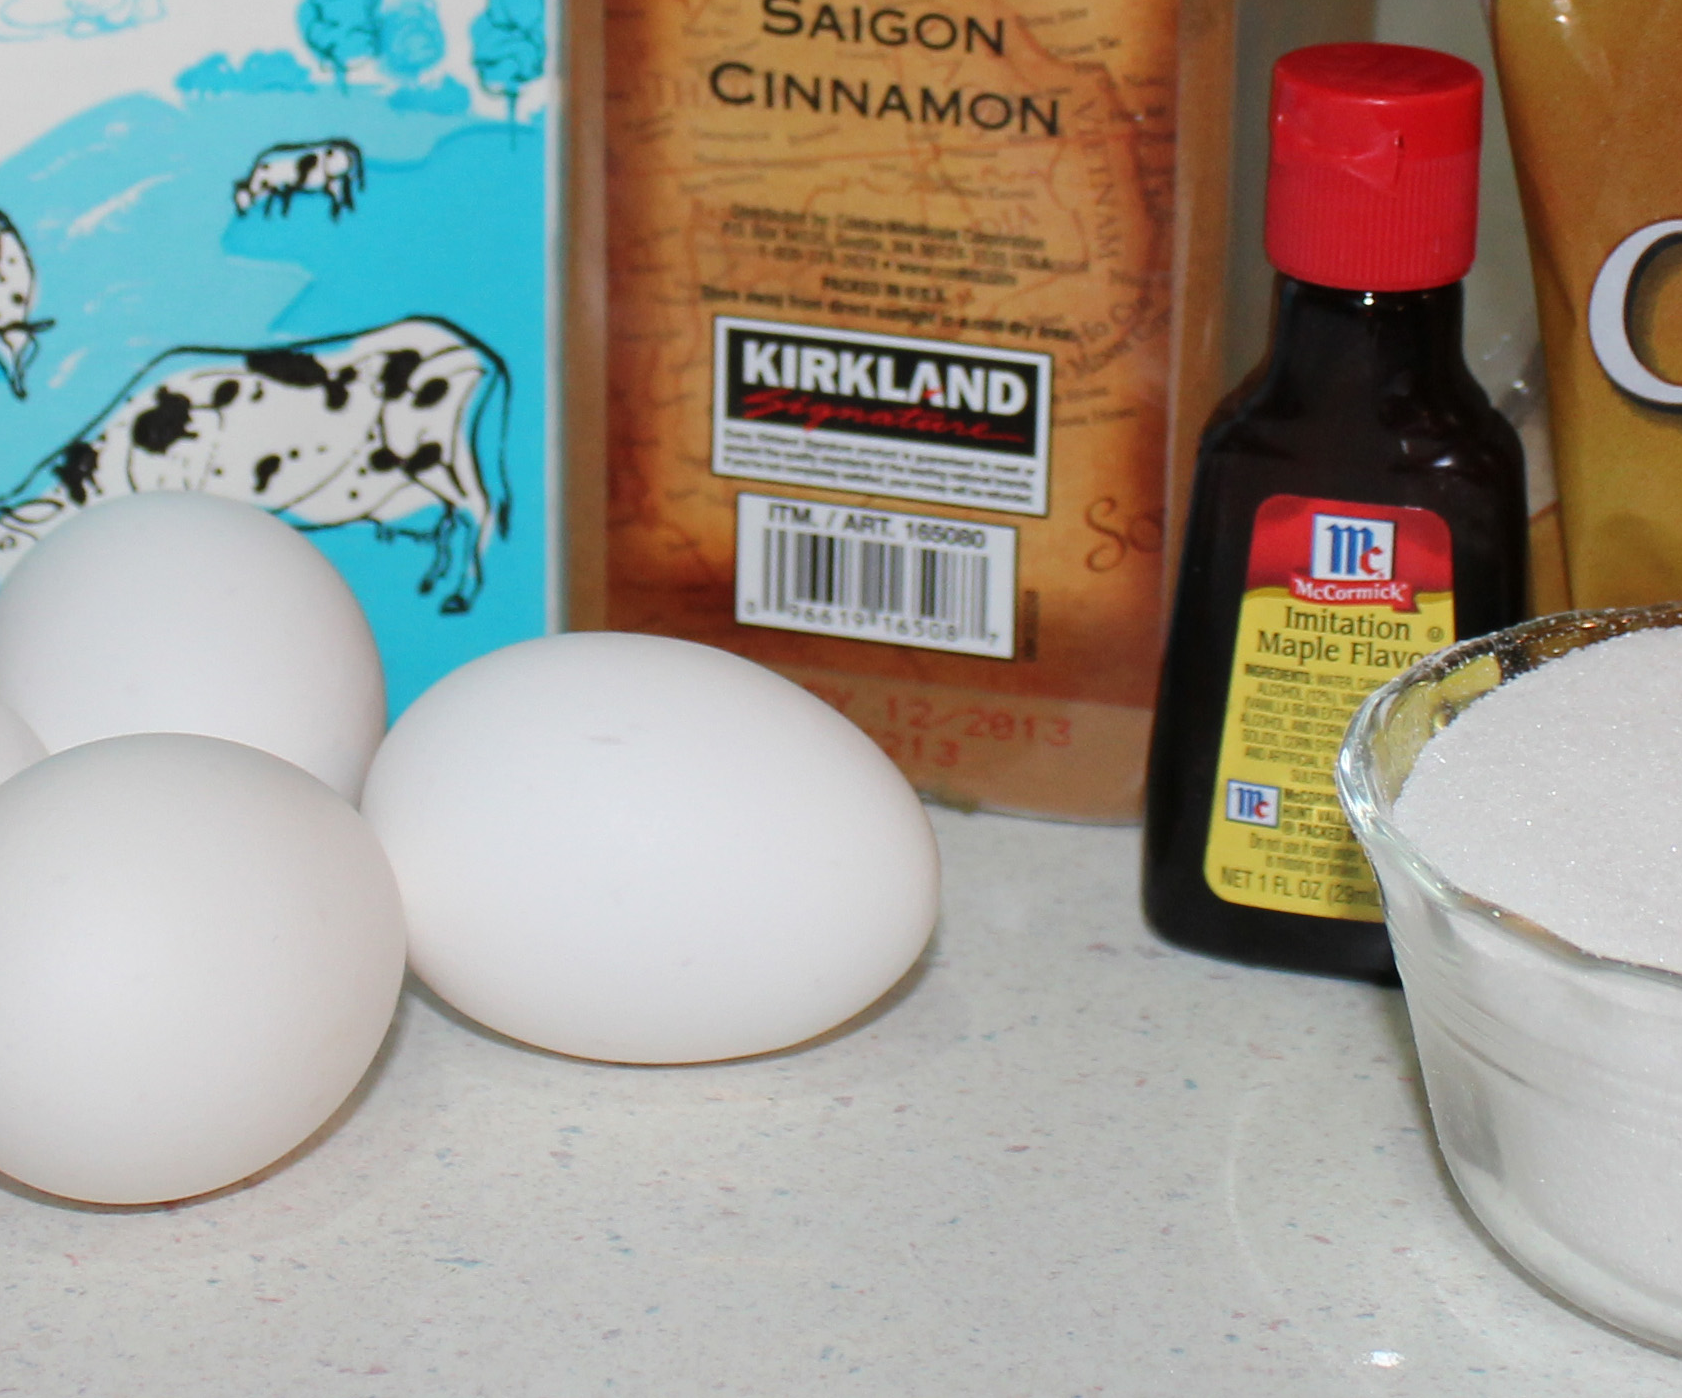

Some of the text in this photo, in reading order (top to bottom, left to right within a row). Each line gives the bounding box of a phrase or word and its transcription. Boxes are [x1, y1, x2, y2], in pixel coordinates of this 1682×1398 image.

[708, 60, 1060, 139] CINNAMON
[741, 338, 1030, 417] KIRKLAND
[767, 504, 819, 526] ITM.
[841, 512, 897, 538] ART.
[905, 520, 987, 550] 165080
[1292, 577, 1404, 602] McCormick
[1284, 605, 1411, 642] Imitation
[1257, 630, 1340, 666] Maple
[1221, 865, 1254, 890] NET
[1259, 874, 1267, 892] 1
[1273, 875, 1294, 897] FL
[1298, 879, 1323, 901] OZ
